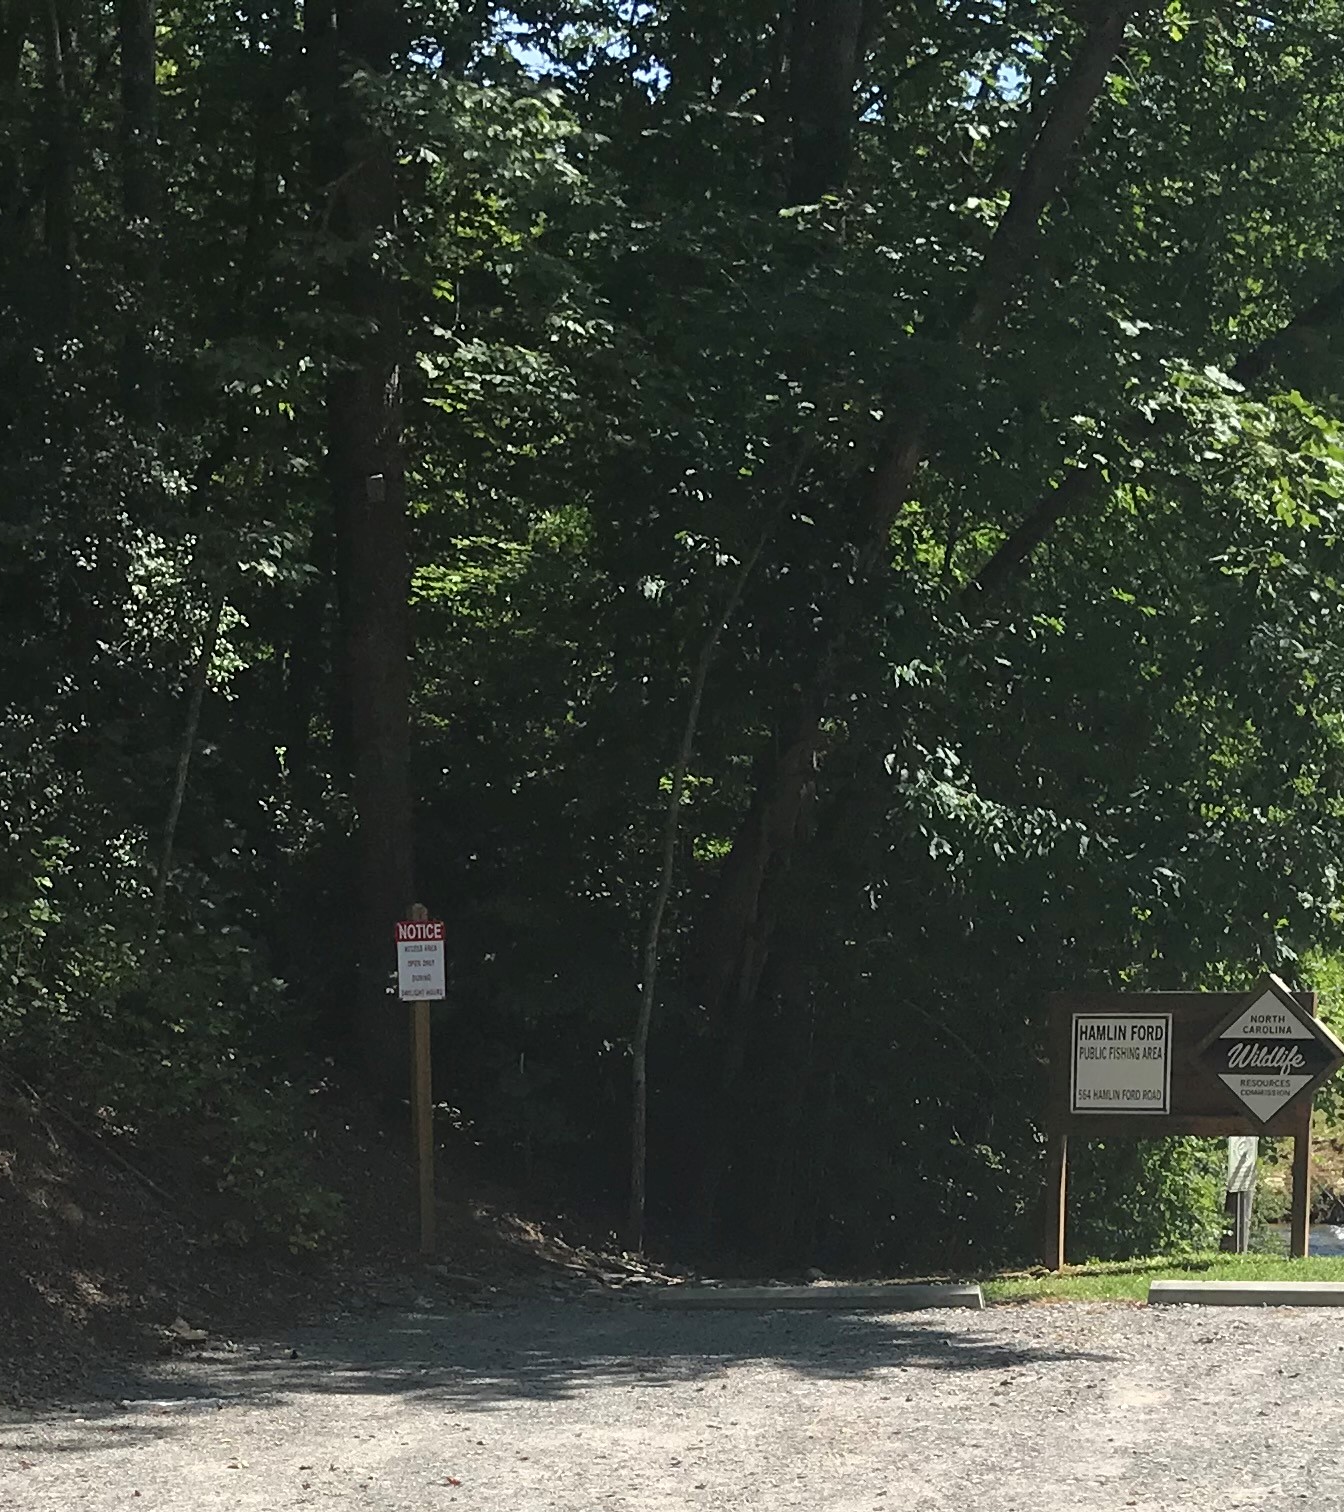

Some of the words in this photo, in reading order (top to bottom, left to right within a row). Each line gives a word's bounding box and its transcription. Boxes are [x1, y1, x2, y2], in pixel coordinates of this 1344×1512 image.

[399, 923, 442, 940] NOTICE
[1250, 1015, 1285, 1023] NORTH
[1079, 1025, 1127, 1041] HAMLIN
[1131, 1025, 1164, 1041] FORD
[1242, 1025, 1292, 1034] CAROLINA
[1079, 1046, 1107, 1060] PUBLIC
[1109, 1046, 1140, 1060] FISHING
[1142, 1046, 1163, 1060] AREA
[1227, 1042, 1306, 1075] Wildlife
[1240, 1079, 1291, 1088] RESOURCES
[1093, 1089, 1120, 1101] HAMLIN
[1122, 1089, 1141, 1101] FORD
[1142, 1089, 1162, 1101] ROAD
[1240, 1089, 1291, 1097] COMMISSION
